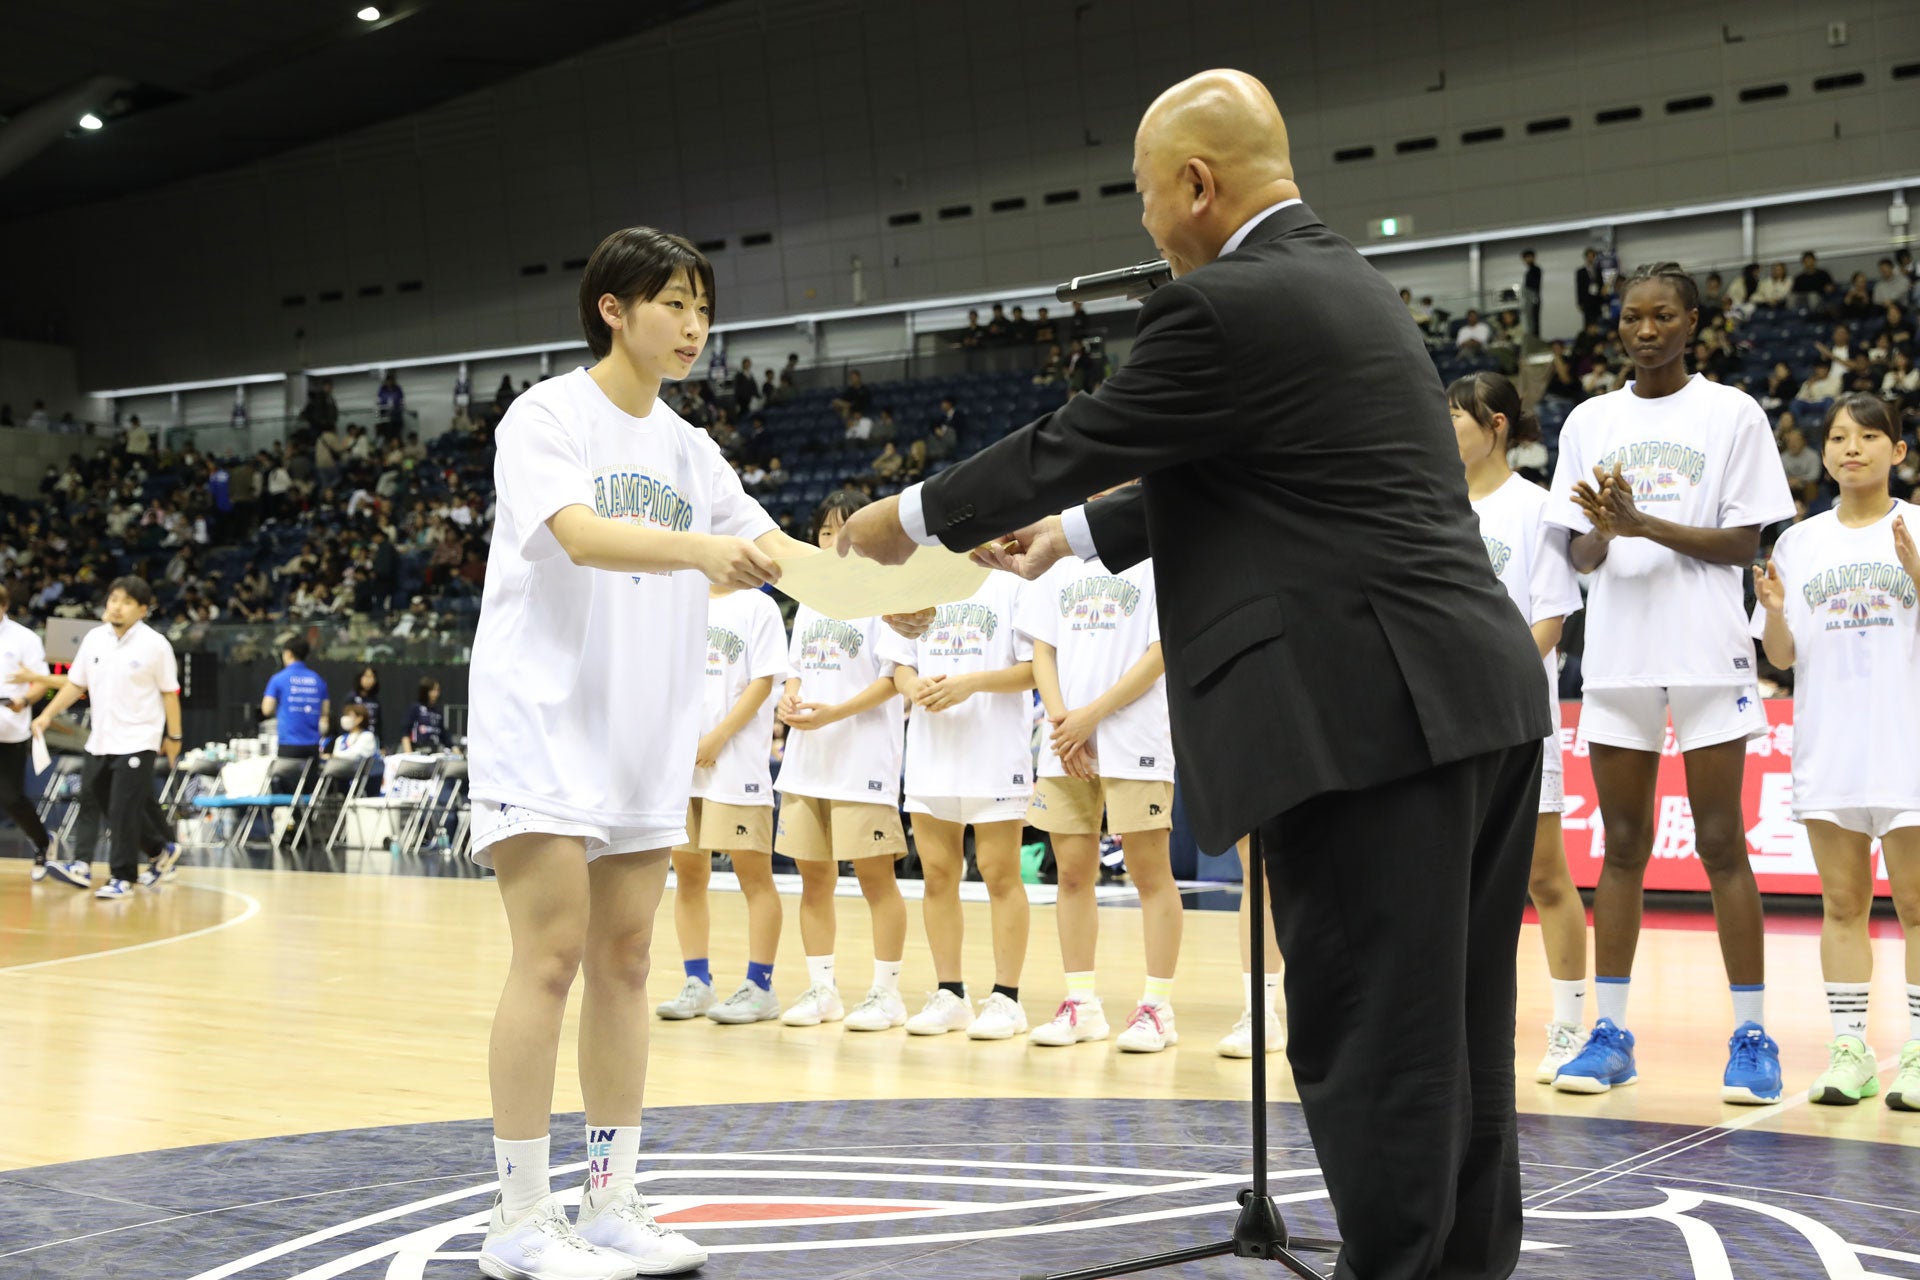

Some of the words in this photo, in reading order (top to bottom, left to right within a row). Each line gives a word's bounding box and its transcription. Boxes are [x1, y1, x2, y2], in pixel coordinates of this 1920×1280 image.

[1598, 441, 1706, 487] HAMPIONS
[594, 472, 693, 532] HAMPIONS
[1060, 575, 1141, 617] CHAMPIONS
[1830, 598, 1848, 611] 20
[590, 1128, 617, 1143] IN
[589, 1143, 612, 1157] HE
[591, 1172, 613, 1189] NT
